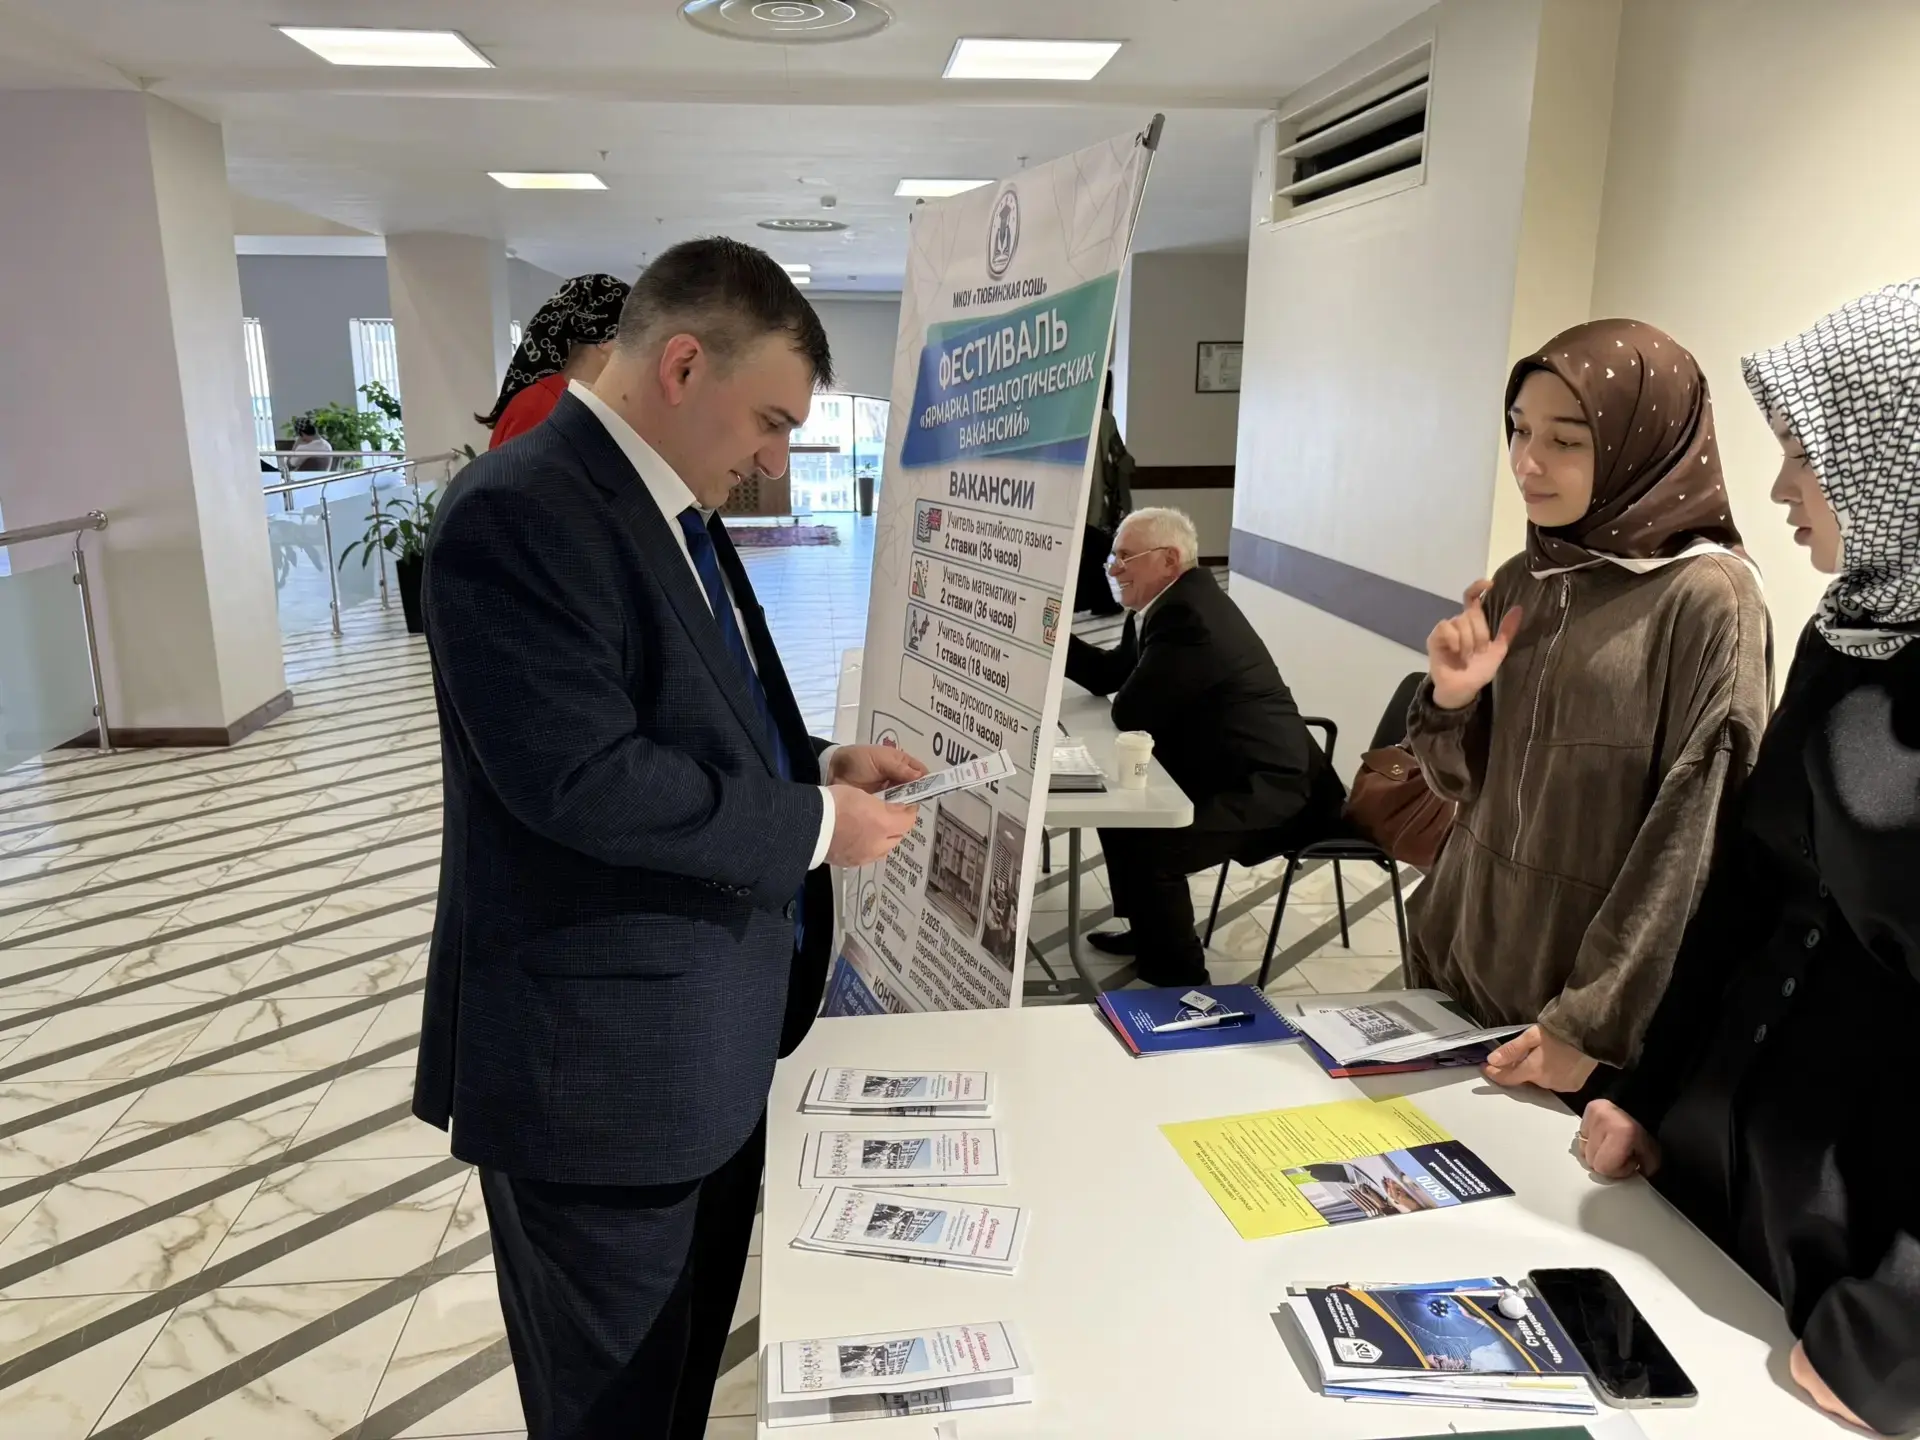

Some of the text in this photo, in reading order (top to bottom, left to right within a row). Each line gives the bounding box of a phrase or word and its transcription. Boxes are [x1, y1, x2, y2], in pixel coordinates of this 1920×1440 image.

[952, 277, 1047, 308] МКОУ «ТЮБИНСКАЯ СОШ»
[938, 308, 1068, 390] ФЕСТИВАЛЬ
[920, 351, 1096, 429] «ЯРМАРКА ПЕДАГОГИЧЕСКИХ
[959, 404, 1030, 449] ВАКАНСИЙ»
[949, 472, 1035, 510] ВАКАНСИИ
[947, 511, 974, 534] Учитель
[976, 520, 1023, 545] английского
[1024, 531, 1053, 551] языка
[945, 533, 1022, 573] 2 ставки (36 часов)
[942, 566, 970, 591] Учитель
[972, 578, 1018, 606] математики
[940, 588, 1017, 634] 2 ставки (36 часов)
[937, 620, 965, 648] Учитель
[966, 625, 1001, 661] биологии
[941, 648, 967, 671] ставка
[967, 656, 981, 677] (18
[982, 664, 1010, 693] часов)
[932, 673, 960, 702] Учитель
[960, 687, 993, 721] русского
[994, 709, 1018, 733] языка
[932, 731, 943, 757] О
[936, 701, 961, 725] ставка
[961, 711, 975, 733] (18
[976, 719, 1003, 749] часов)
[925, 912, 940, 933] 2025
[951, 937, 978, 970] проведен
[979, 961, 1011, 999] капитальн
[1416, 1175, 1451, 1201] СКПО
[1517, 1320, 1540, 1347] Стань
